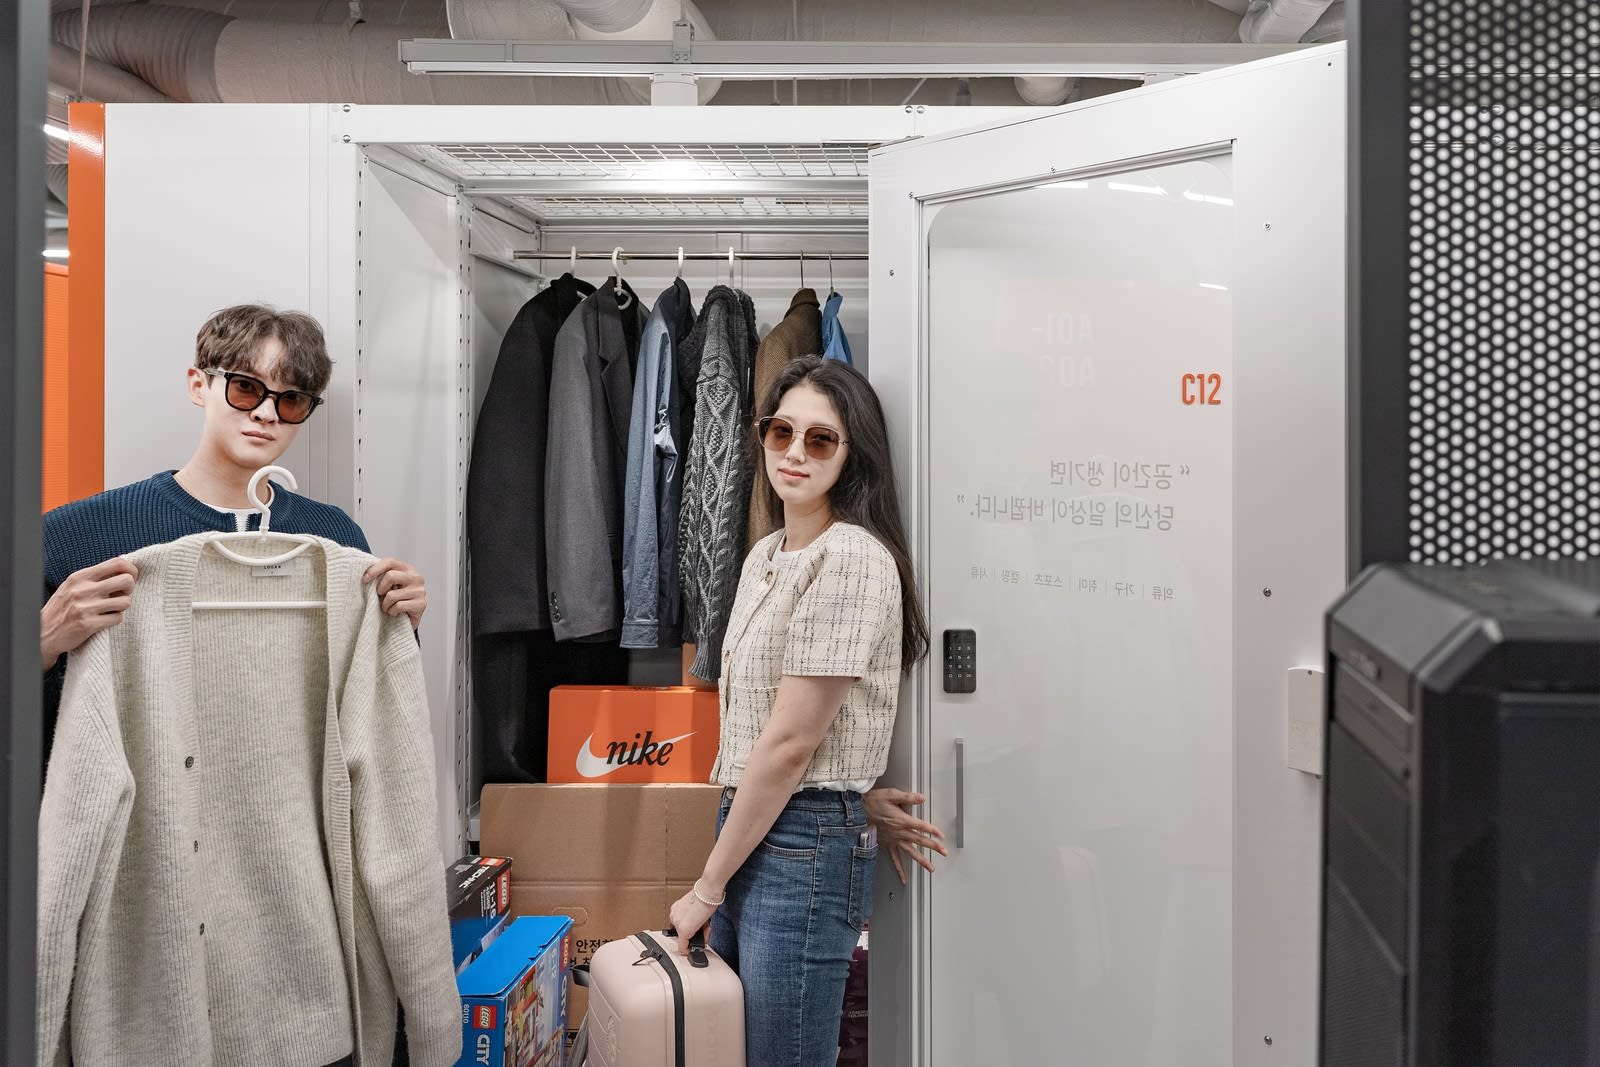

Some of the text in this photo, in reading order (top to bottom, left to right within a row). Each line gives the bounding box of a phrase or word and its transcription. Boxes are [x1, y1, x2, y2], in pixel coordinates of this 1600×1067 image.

[1182, 373, 1221, 405] C12
[606, 731, 674, 766] nike
[501, 873, 509, 908] LEGO
[576, 939, 613, 954] 안전
[476, 1005, 491, 1066] LEGO CITY
